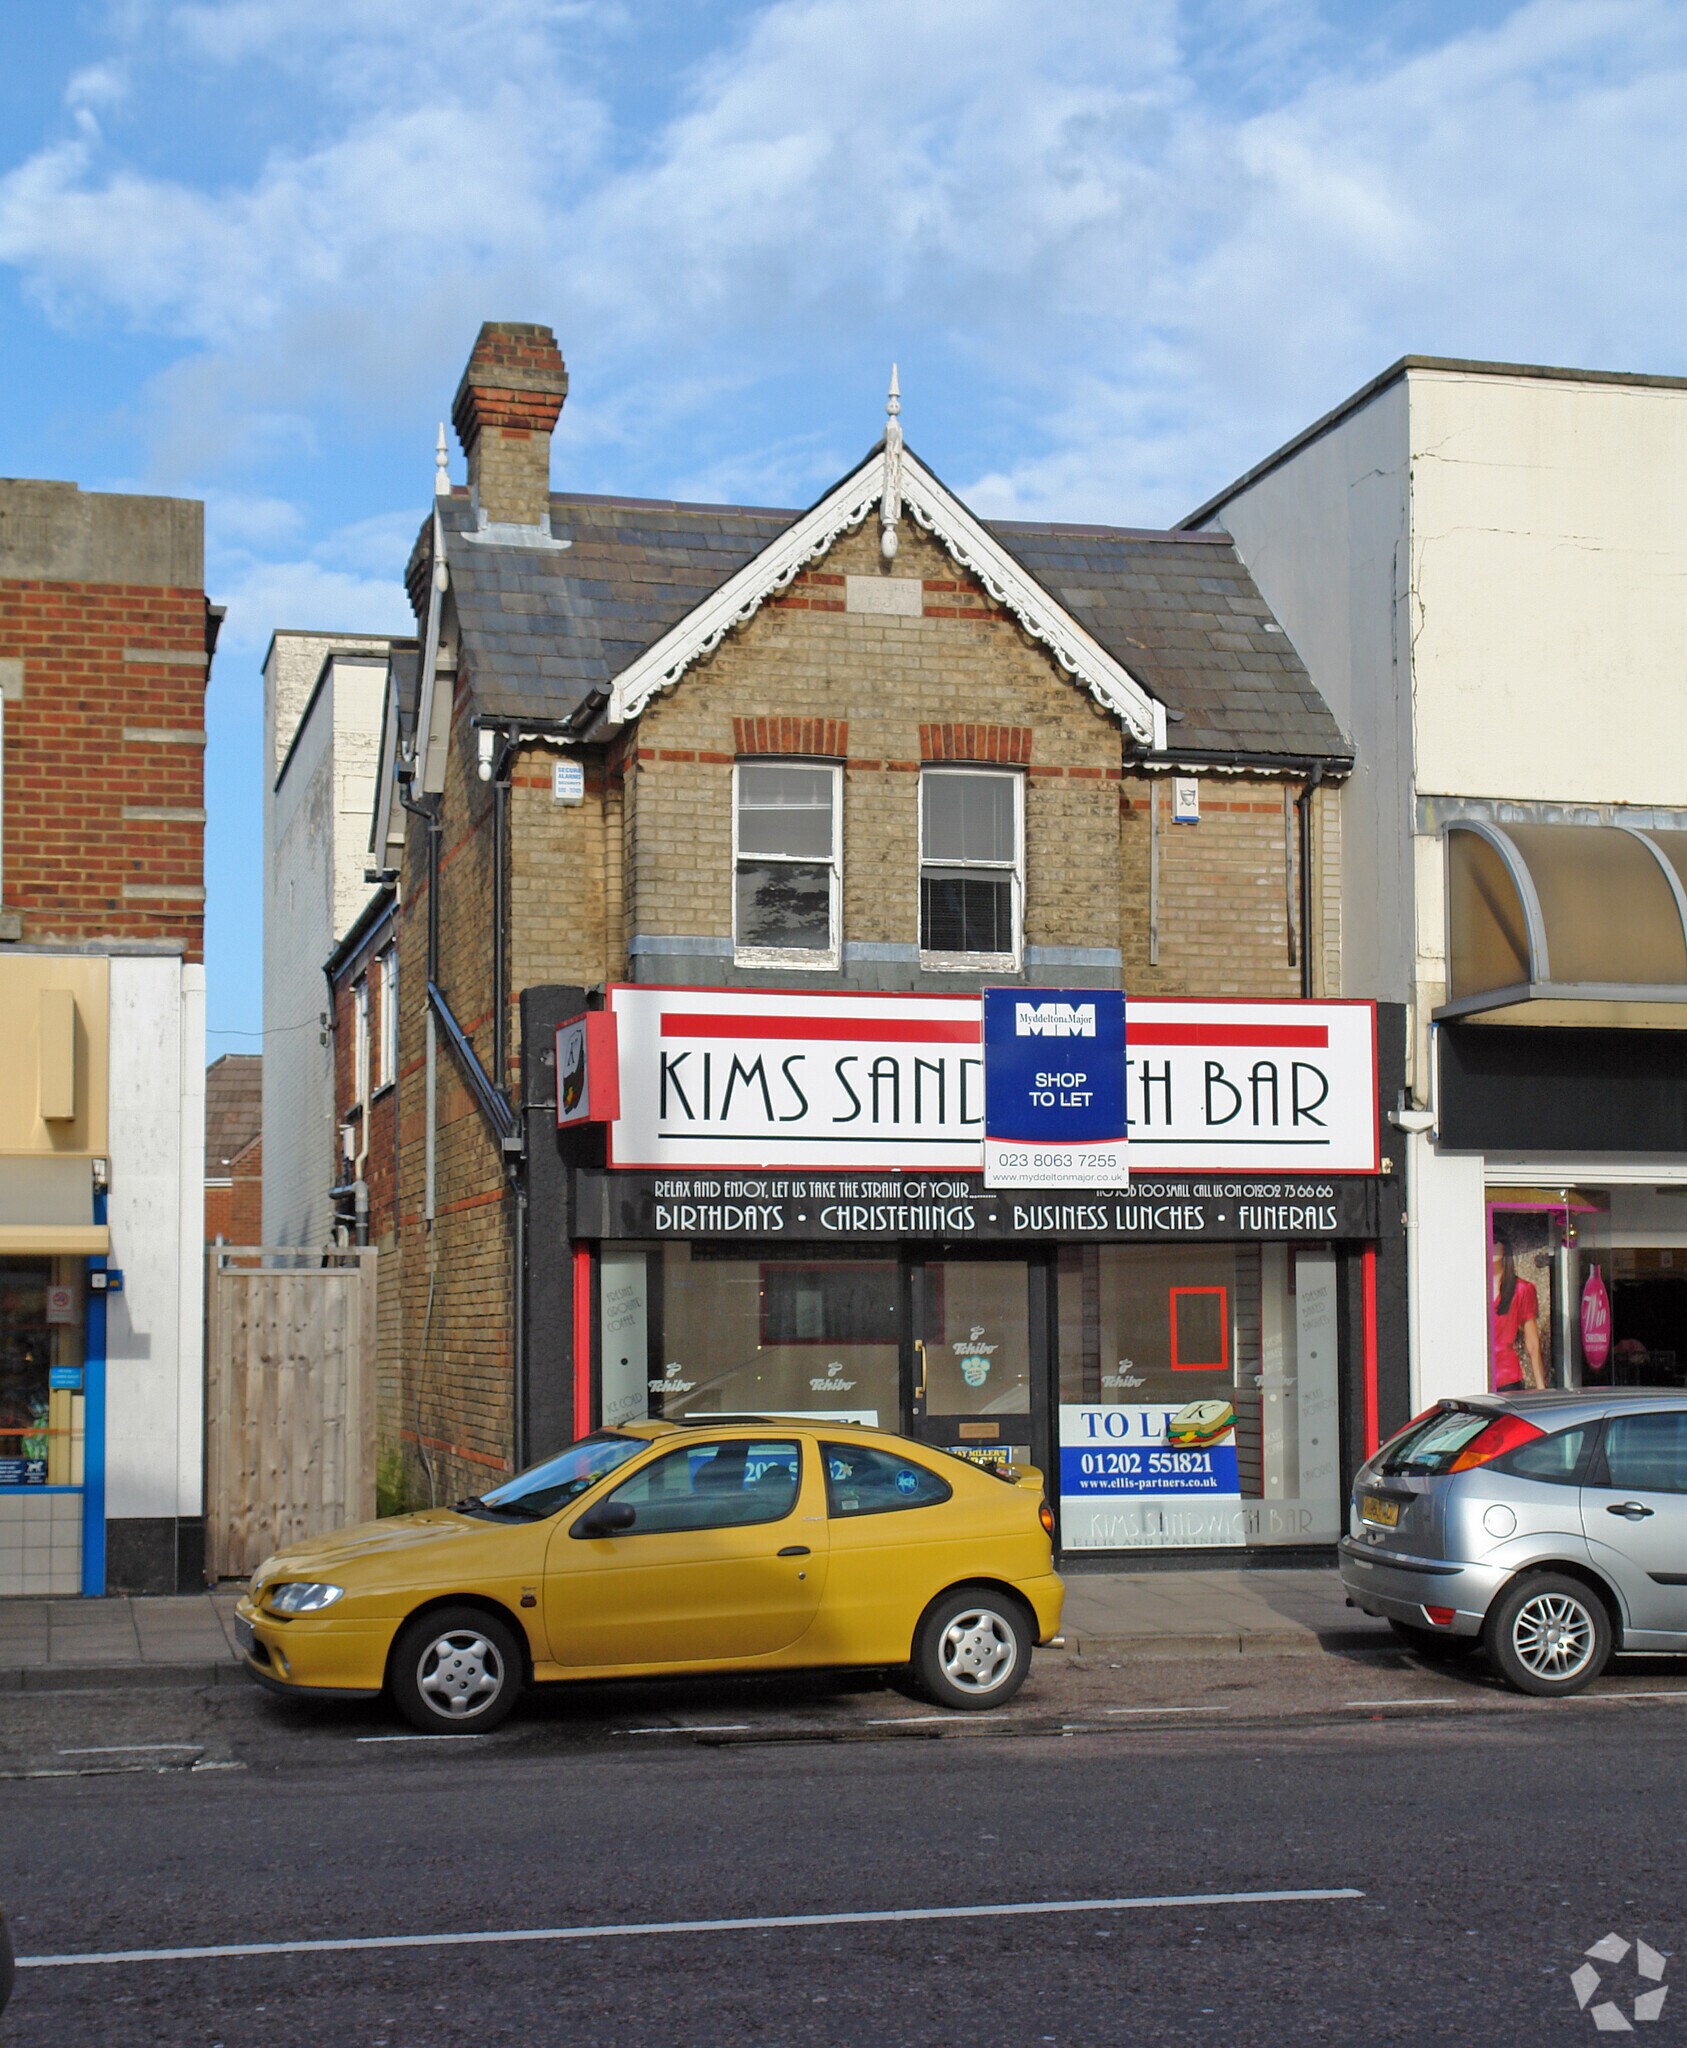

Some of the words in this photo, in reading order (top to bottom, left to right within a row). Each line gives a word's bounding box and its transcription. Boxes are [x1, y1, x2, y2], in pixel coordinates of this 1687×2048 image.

[1035, 1072, 1087, 1088] SHOP
[659, 1051, 809, 1122] KIMS
[1204, 1060, 1330, 1127] BAR
[1029, 1092, 1056, 1107] TO
[1060, 1092, 1093, 1107] LET
[998, 1153, 1028, 1167] 023
[1033, 1154, 1073, 1167] 8063
[1078, 1154, 1117, 1168] 7255
[992, 1172, 1123, 1184] www.myddeltonmajor.co.uk
[654, 1180, 692, 1198] RELAX
[693, 1181, 721, 1198] AND
[724, 1181, 769, 1199] ENJOY,
[771, 1181, 789, 1198] LET
[792, 1181, 807, 1198] US
[808, 1181, 836, 1198] TAKE
[838, 1182, 859, 1198] THE
[861, 1182, 901, 1198] STRAIN
[903, 1182, 928, 1198] OF
[1138, 1184, 1165, 1198] TOO
[1166, 1184, 1190, 1198] SMALL
[1193, 1184, 1212, 1198] CALL
[1213, 1184, 1223, 1198] US
[1224, 1184, 1241, 1198] ON
[1243, 1184, 1281, 1198] 01202
[1297, 1184, 1314, 1198] 66
[1316, 1184, 1334, 1198] 66
[655, 1205, 785, 1231] BIRTHDAYS
[820, 1205, 976, 1231] CHRISTENINGS
[1013, 1205, 1109, 1231] BUSINESS
[1115, 1205, 1205, 1231] LUNCHES
[1239, 1205, 1338, 1231] FUNERALS
[952, 1342, 999, 1355] Tchibo
[648, 1379, 696, 1393] Tchibo
[809, 1378, 856, 1392] Tchibo
[1101, 1375, 1146, 1388] Tchibo
[1081, 1411, 1130, 1438] TO
[1081, 1453, 1142, 1474] 01202
[1149, 1452, 1214, 1474] 551821
[1080, 1477, 1218, 1490] www.ellis-partners.co.uk
[1091, 1512, 1140, 1537] KIMS
[1270, 1508, 1313, 1534] BAR
